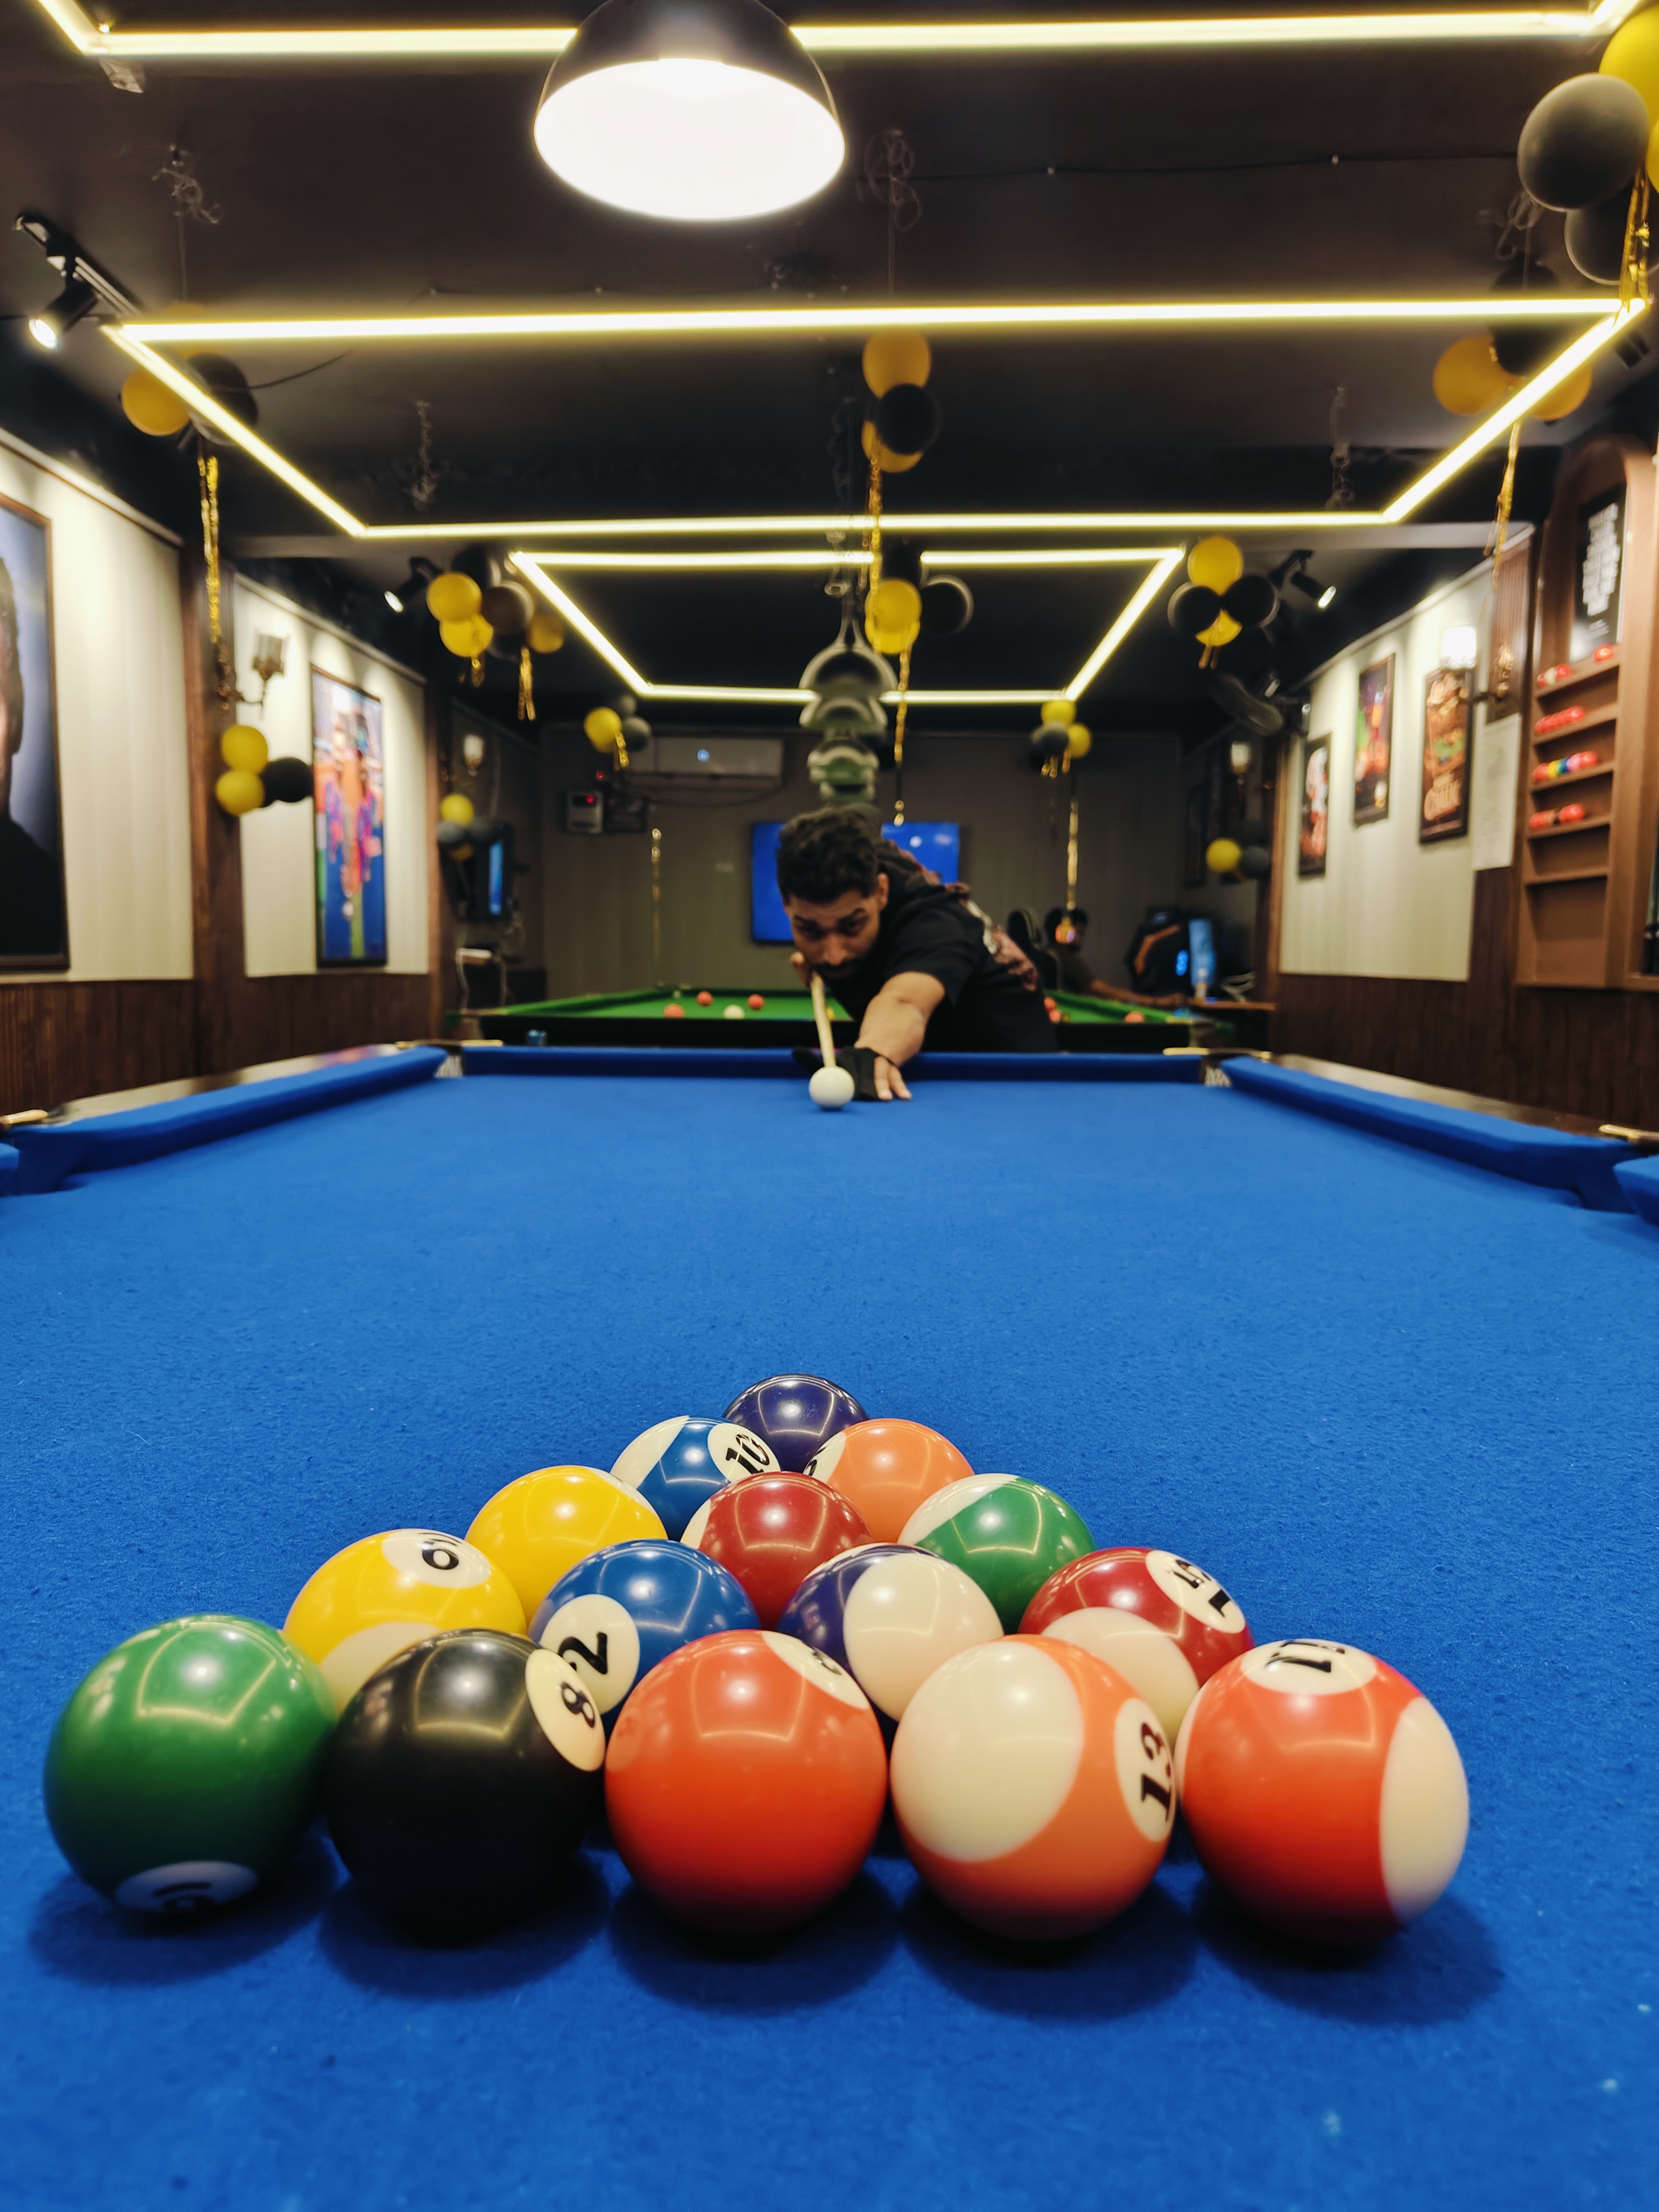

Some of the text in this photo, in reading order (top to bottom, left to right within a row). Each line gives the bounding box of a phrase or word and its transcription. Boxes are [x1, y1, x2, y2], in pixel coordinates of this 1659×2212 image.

[726, 1434, 770, 1475] 10
[558, 1631, 608, 1675] 2
[561, 1683, 595, 1729] 8
[1141, 1723, 1172, 1822] 13
